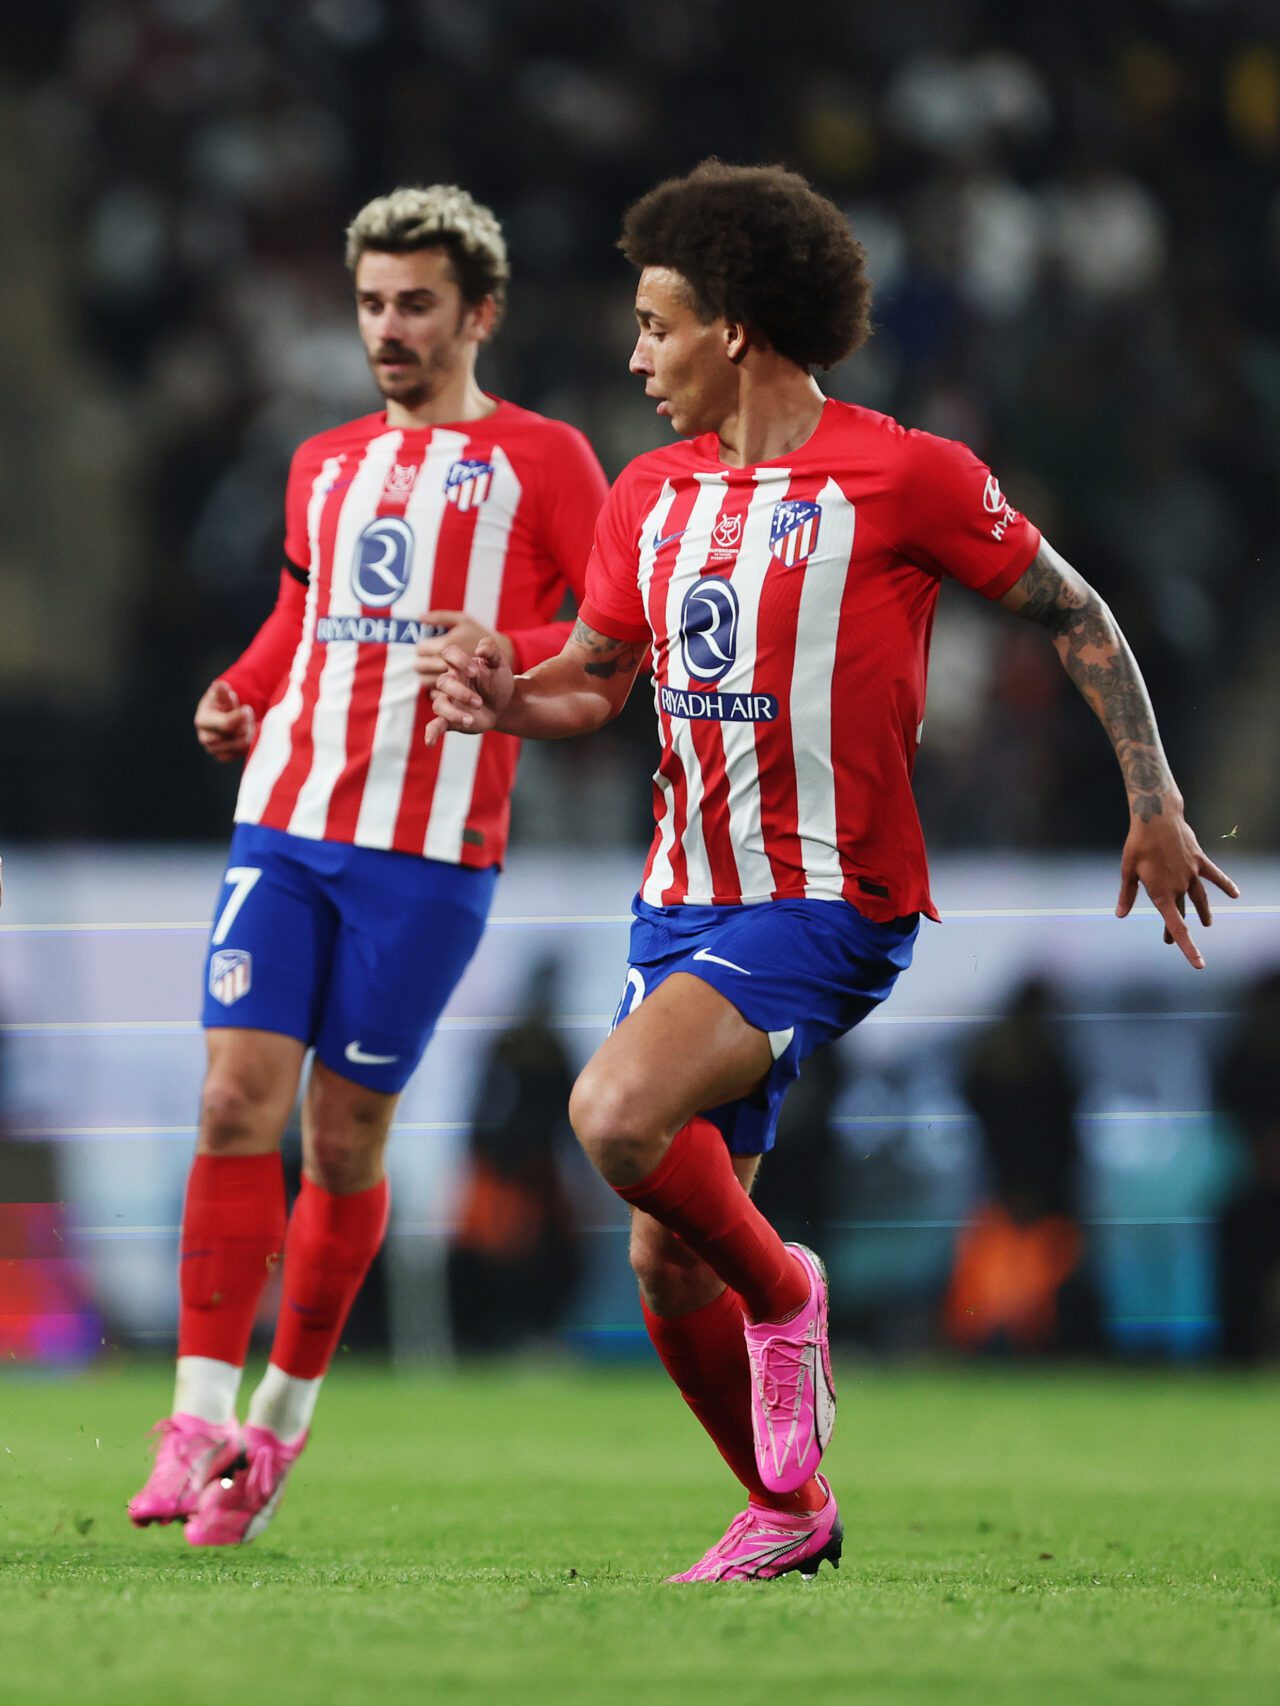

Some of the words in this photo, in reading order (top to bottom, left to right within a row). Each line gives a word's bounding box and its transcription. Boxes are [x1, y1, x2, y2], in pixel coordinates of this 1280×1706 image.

[317, 618, 398, 642] RIYADH
[661, 688, 724, 718] RIYADH
[730, 695, 773, 719] AIR
[212, 867, 262, 946] 7
[611, 967, 646, 1032] 0
